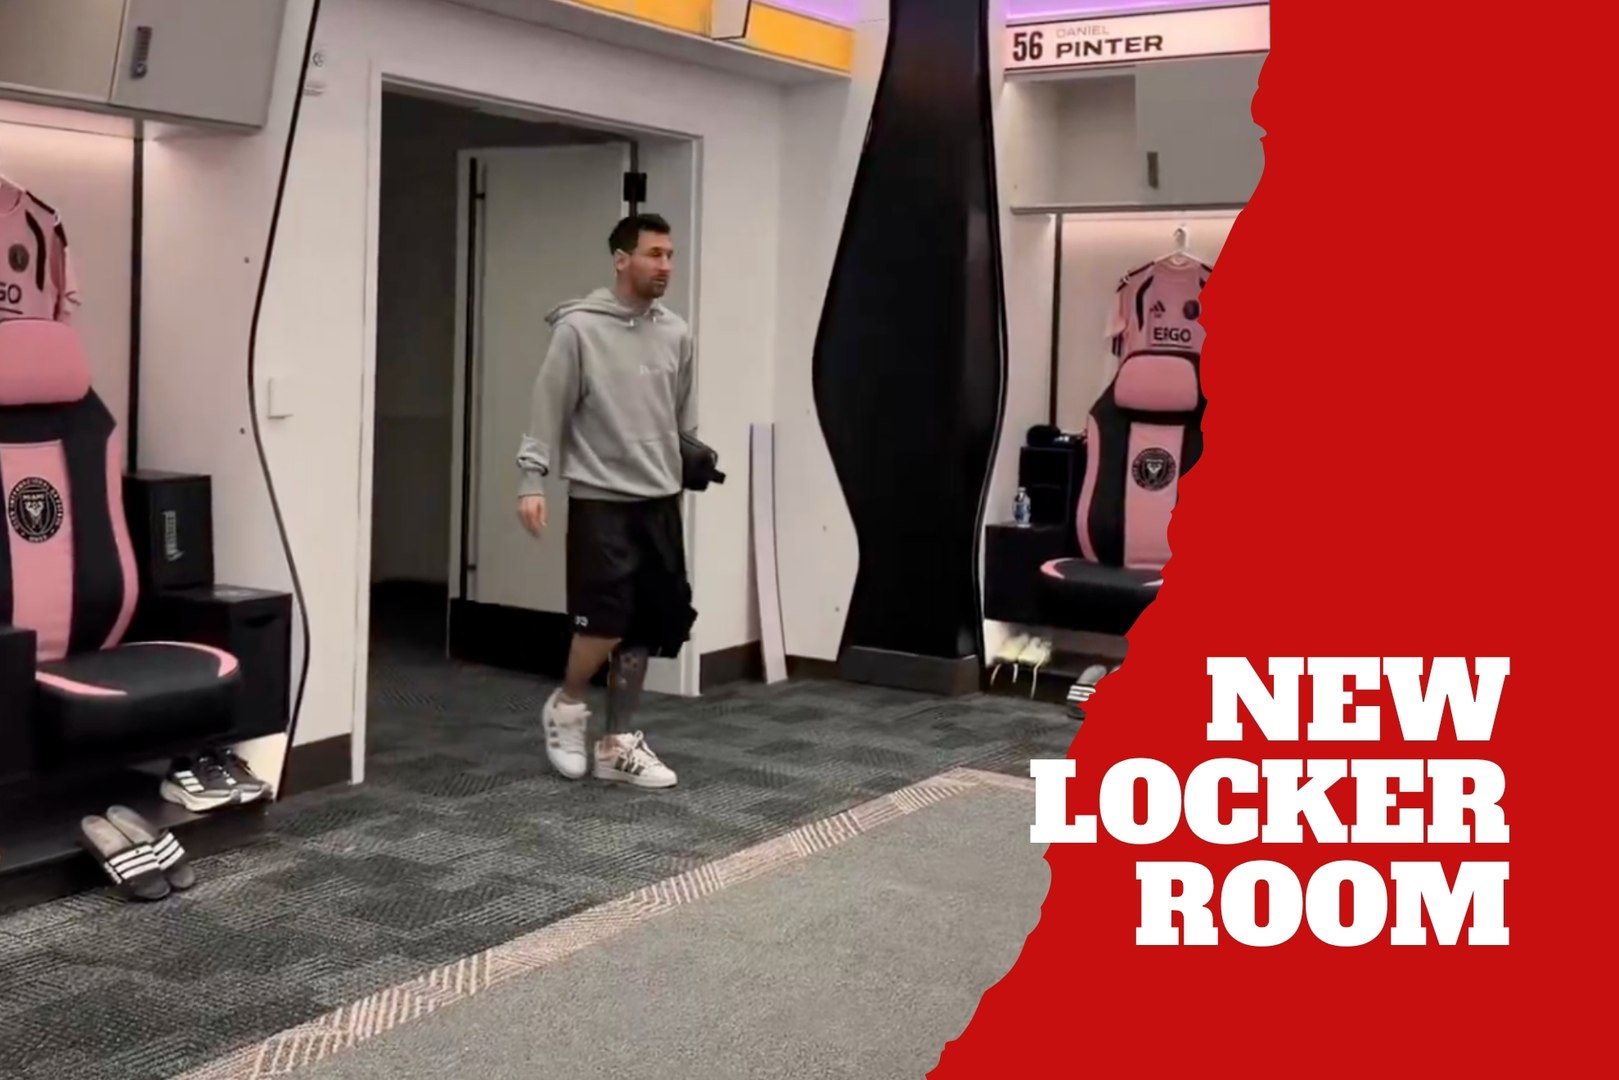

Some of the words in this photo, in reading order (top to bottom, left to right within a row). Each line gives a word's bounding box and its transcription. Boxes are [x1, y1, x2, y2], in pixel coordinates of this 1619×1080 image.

[1056, 25, 1110, 38] DANIEL
[1012, 31, 1043, 62] 56
[1056, 35, 1163, 59] PINTER
